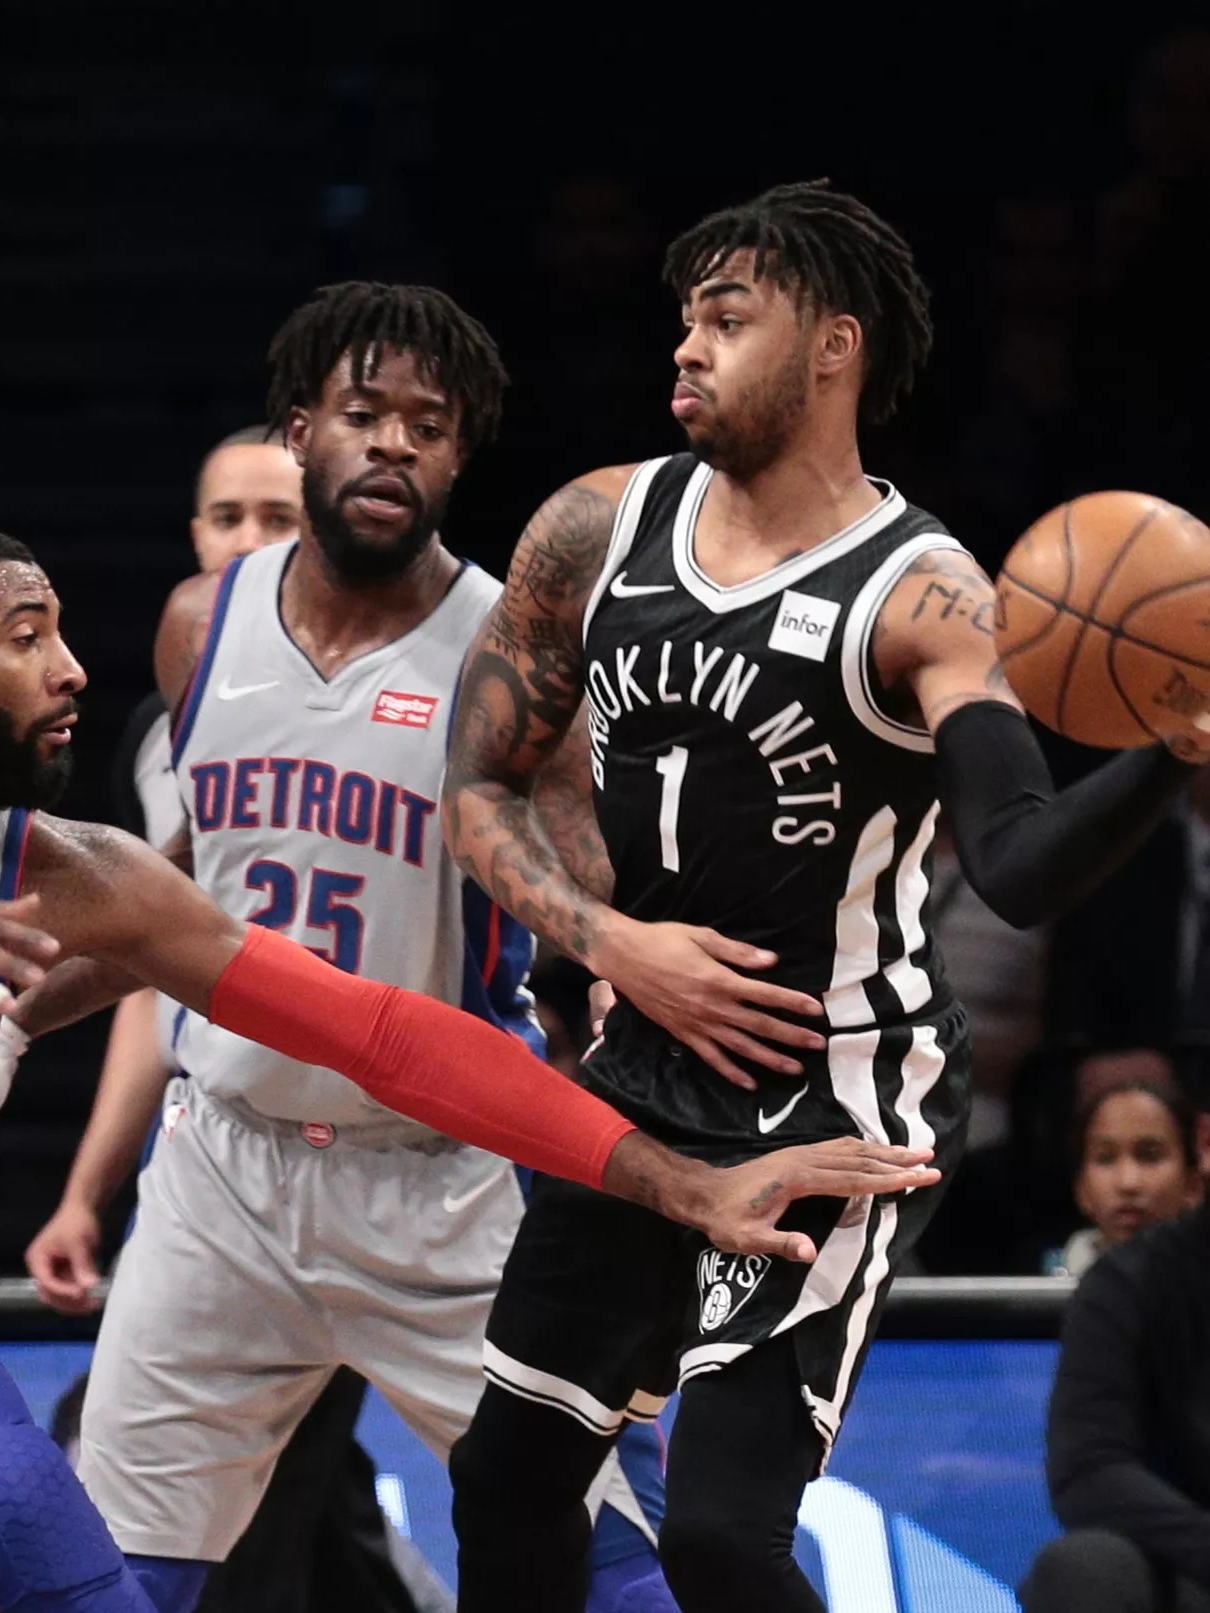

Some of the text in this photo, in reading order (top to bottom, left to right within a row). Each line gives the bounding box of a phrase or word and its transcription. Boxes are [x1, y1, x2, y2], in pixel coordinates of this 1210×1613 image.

[780, 608, 829, 638] infor
[190, 757, 436, 867] DETROIT
[654, 744, 689, 874] 1
[748, 701, 841, 846] NETS
[245, 859, 366, 975] 25
[700, 1251, 762, 1288] NETS
